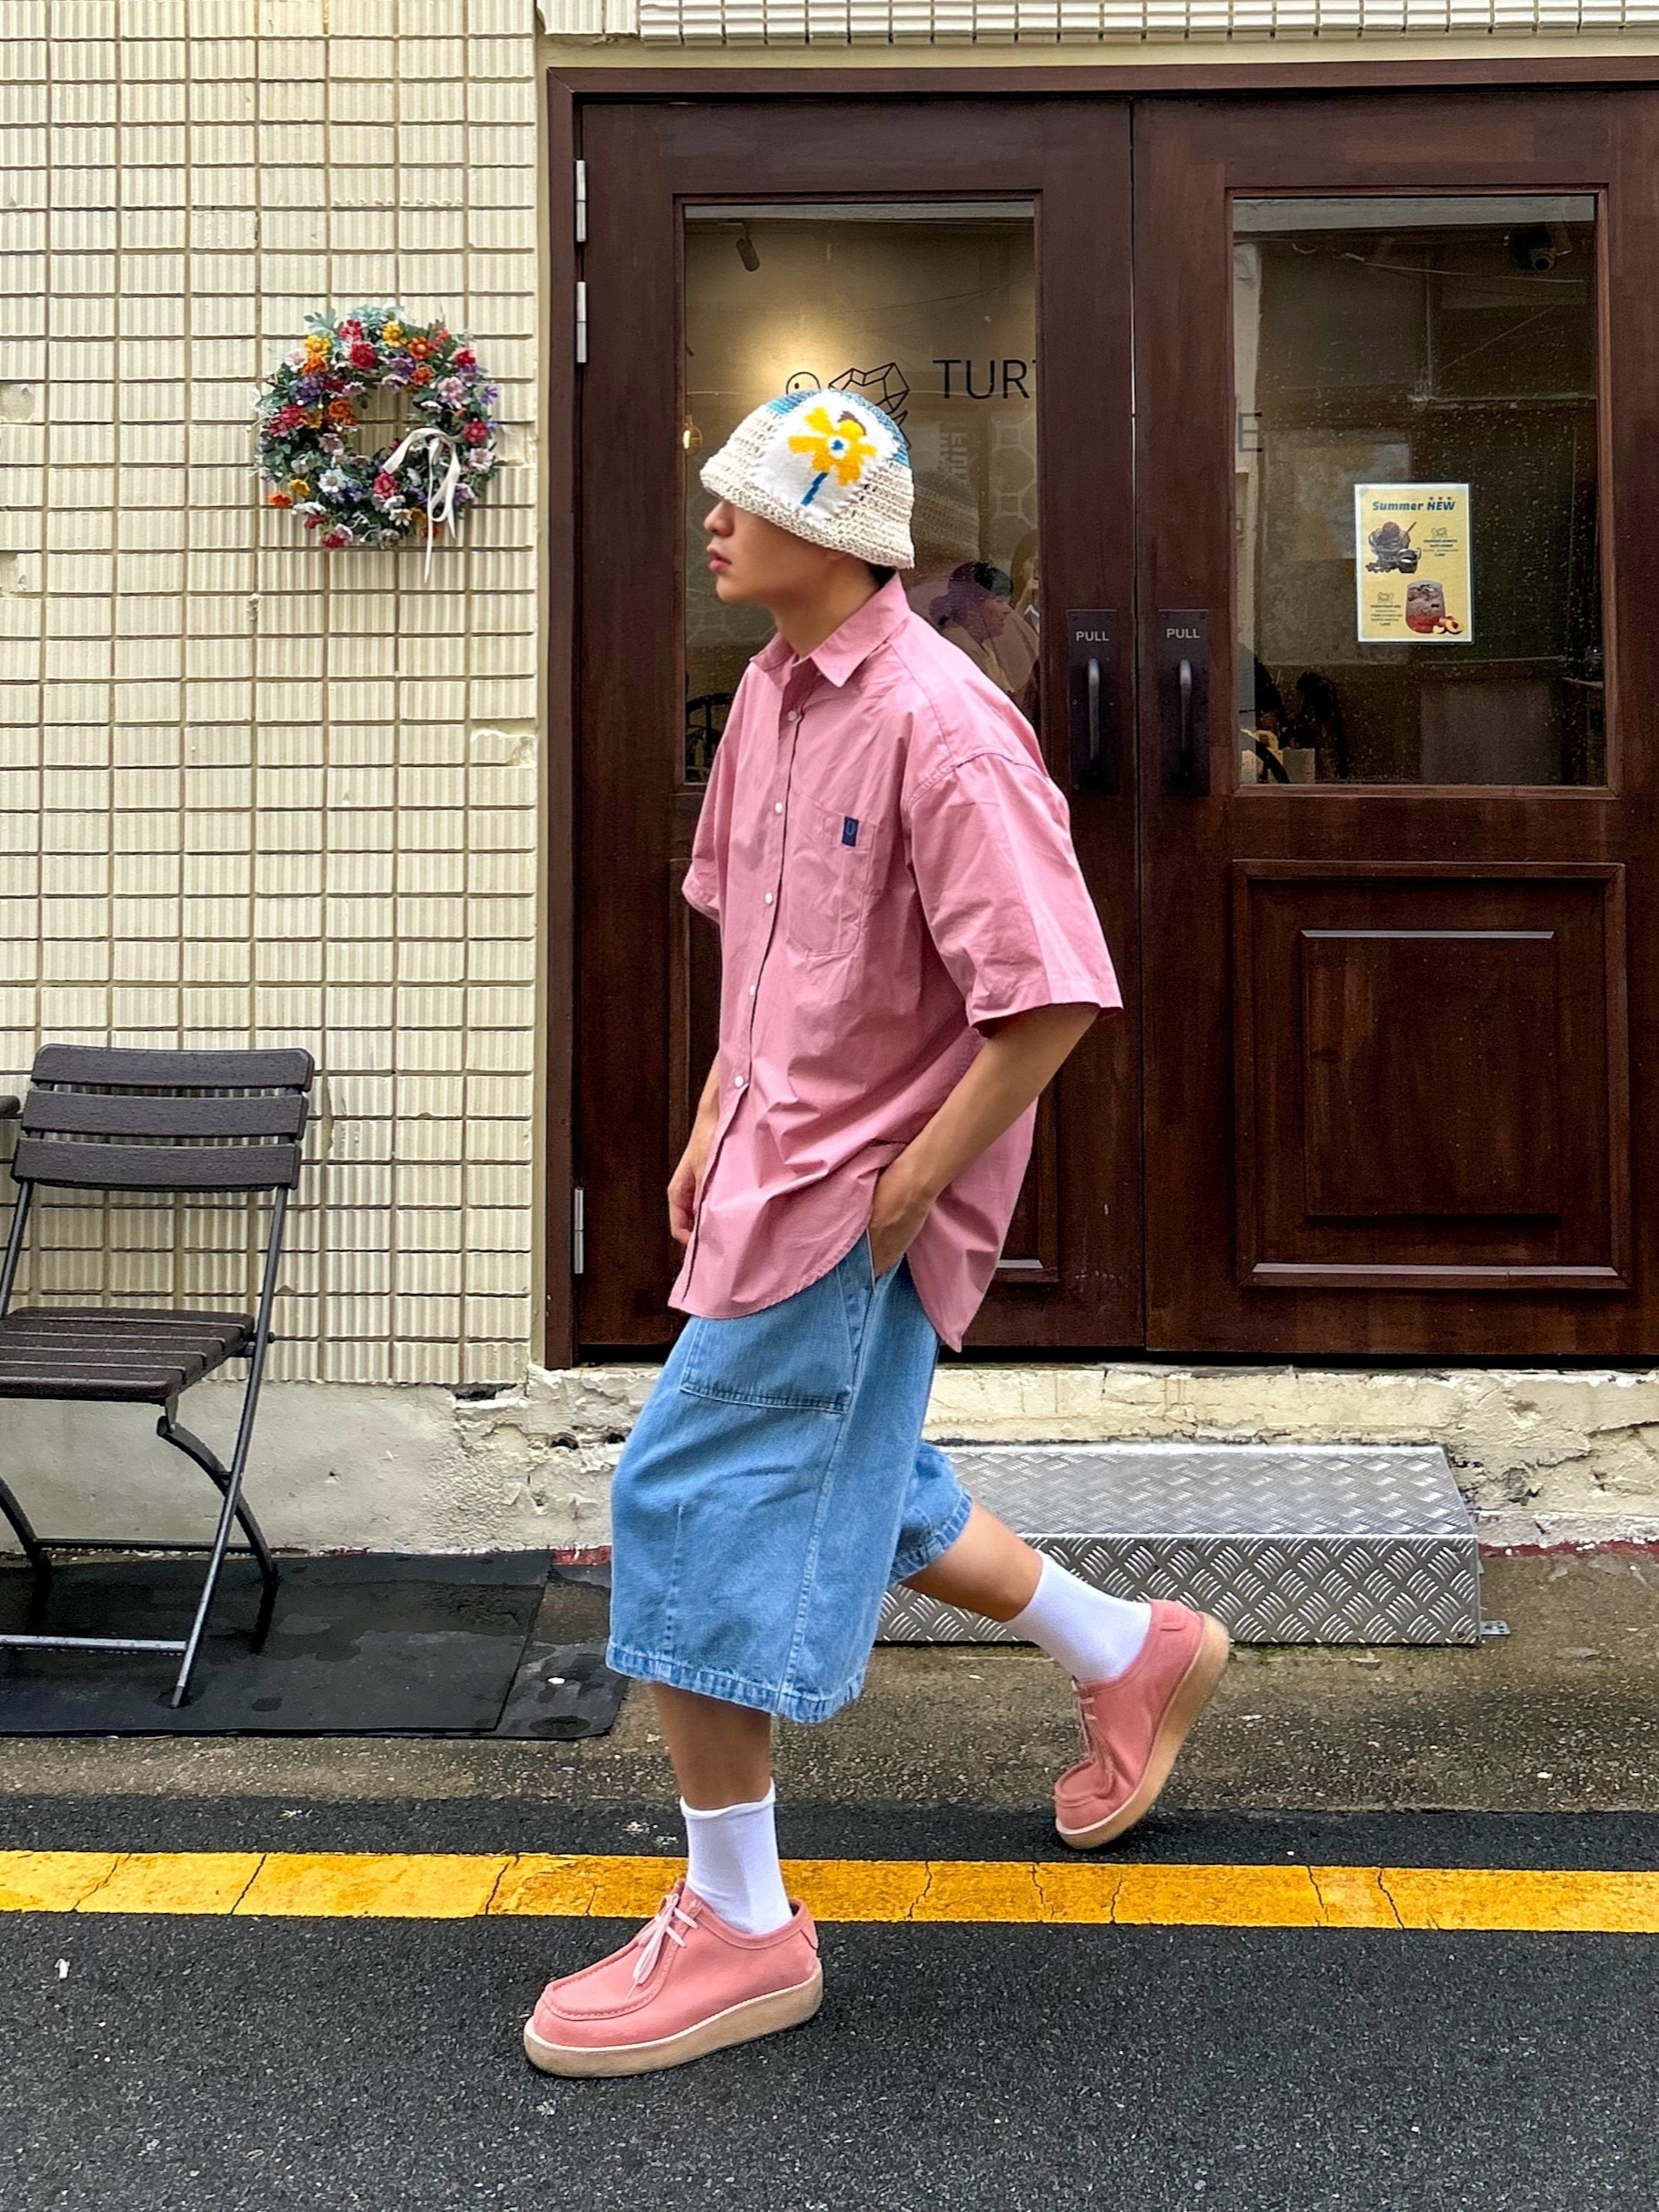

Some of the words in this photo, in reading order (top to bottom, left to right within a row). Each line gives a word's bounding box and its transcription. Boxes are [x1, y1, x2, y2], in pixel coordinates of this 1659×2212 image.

[932, 359, 1037, 400] TUR
[1372, 501, 1424, 511] Summer
[1427, 501, 1456, 511] NEW
[1076, 630, 1110, 643] PULL
[1166, 628, 1201, 640] PULL
